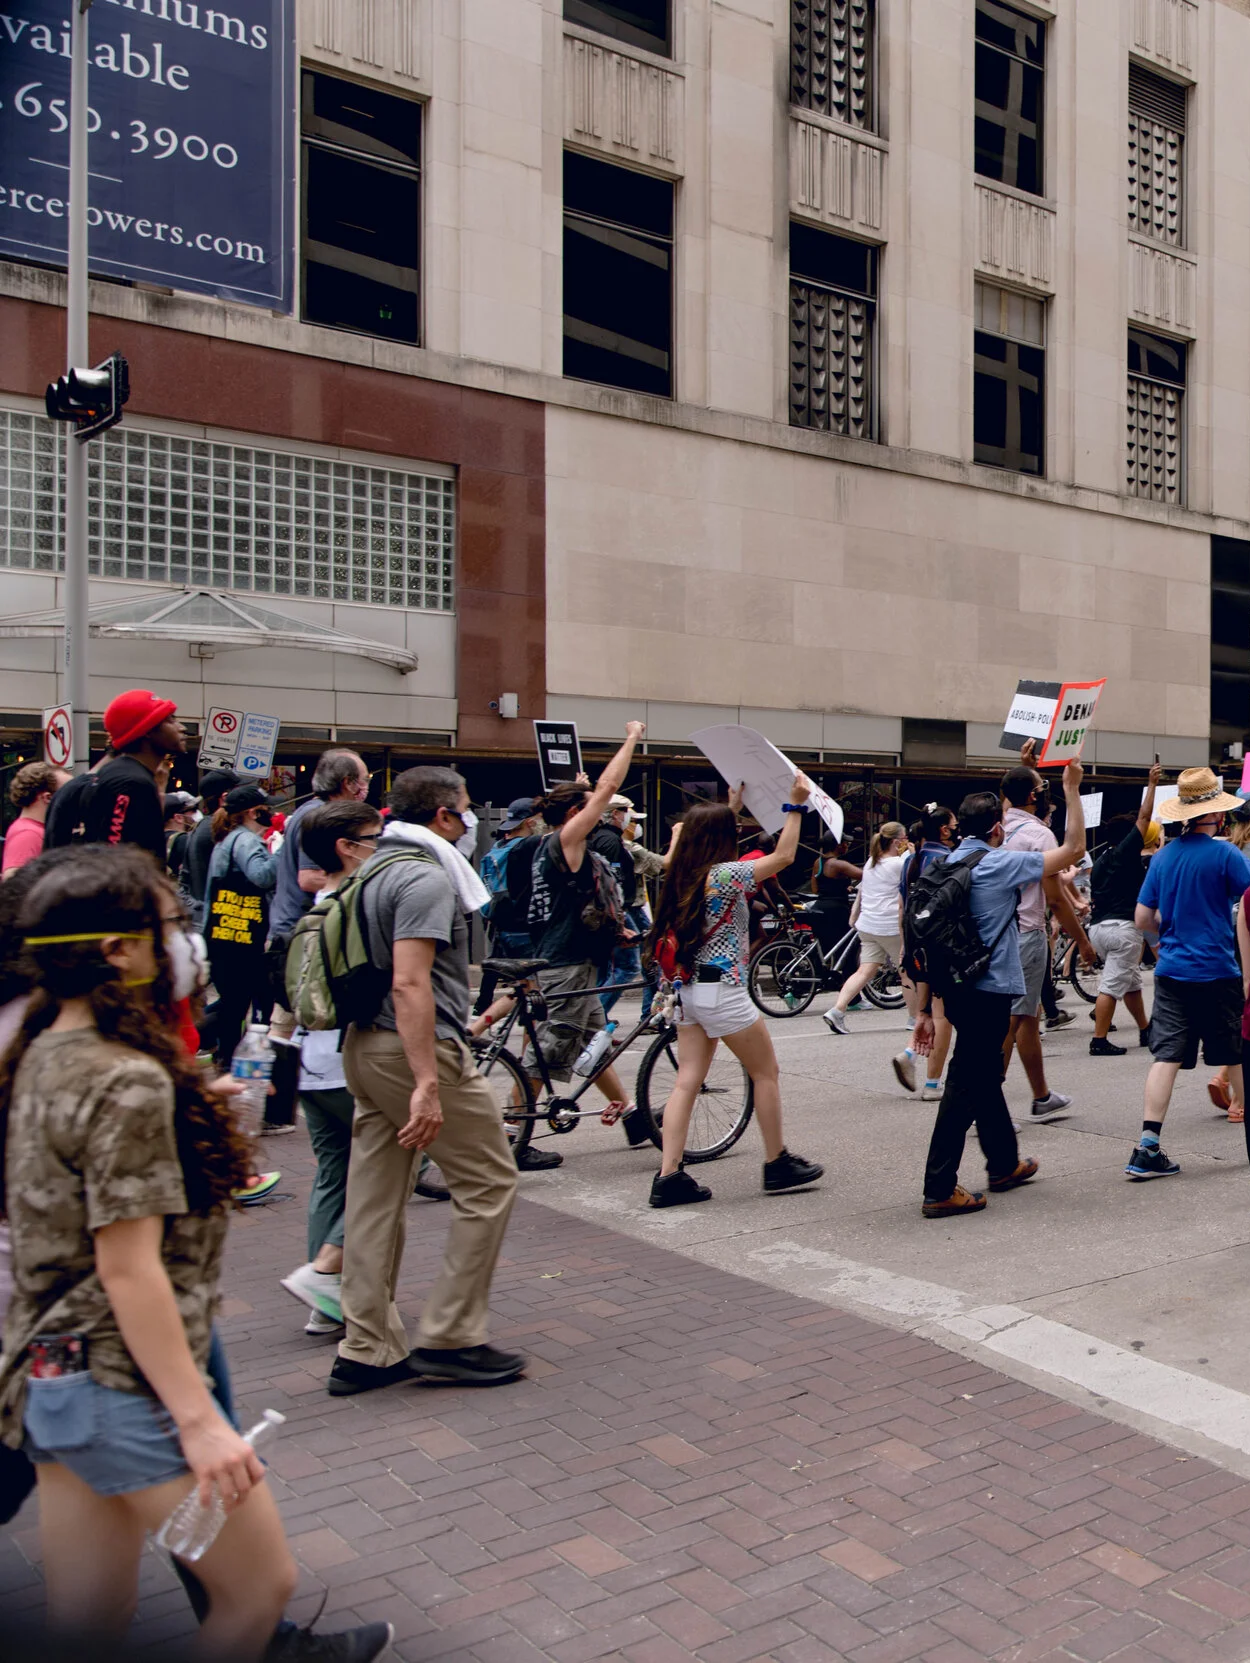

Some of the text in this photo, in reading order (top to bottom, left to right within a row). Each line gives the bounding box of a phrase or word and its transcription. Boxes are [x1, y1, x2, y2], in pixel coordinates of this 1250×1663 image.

[0, 13, 190, 90] vaiable
[243, 896, 262, 908] SEE
[219, 914, 249, 931] CHEER
